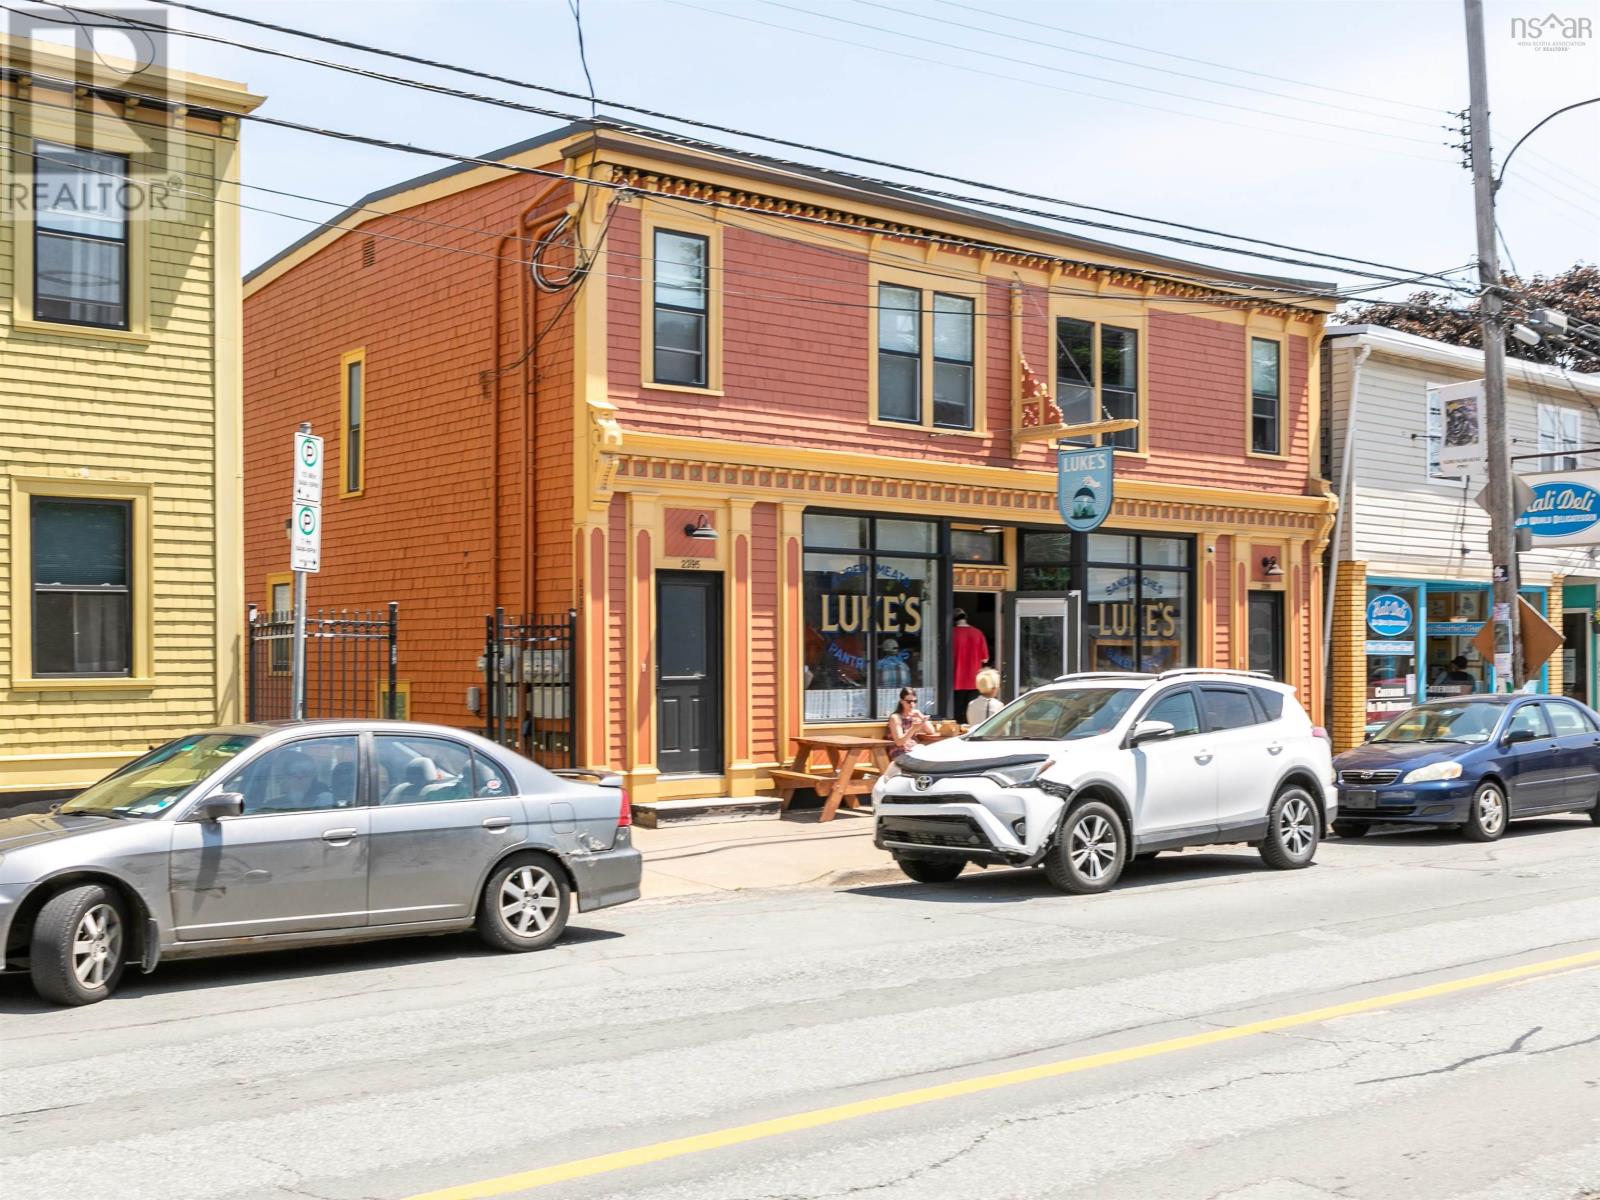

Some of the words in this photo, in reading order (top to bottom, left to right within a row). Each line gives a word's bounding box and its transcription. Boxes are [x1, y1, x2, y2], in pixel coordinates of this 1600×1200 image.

[1063, 454, 1106, 473] LUKE'S
[1526, 490, 1556, 512] ali
[1556, 488, 1596, 512] Deli
[821, 593, 922, 633] LUKE'S
